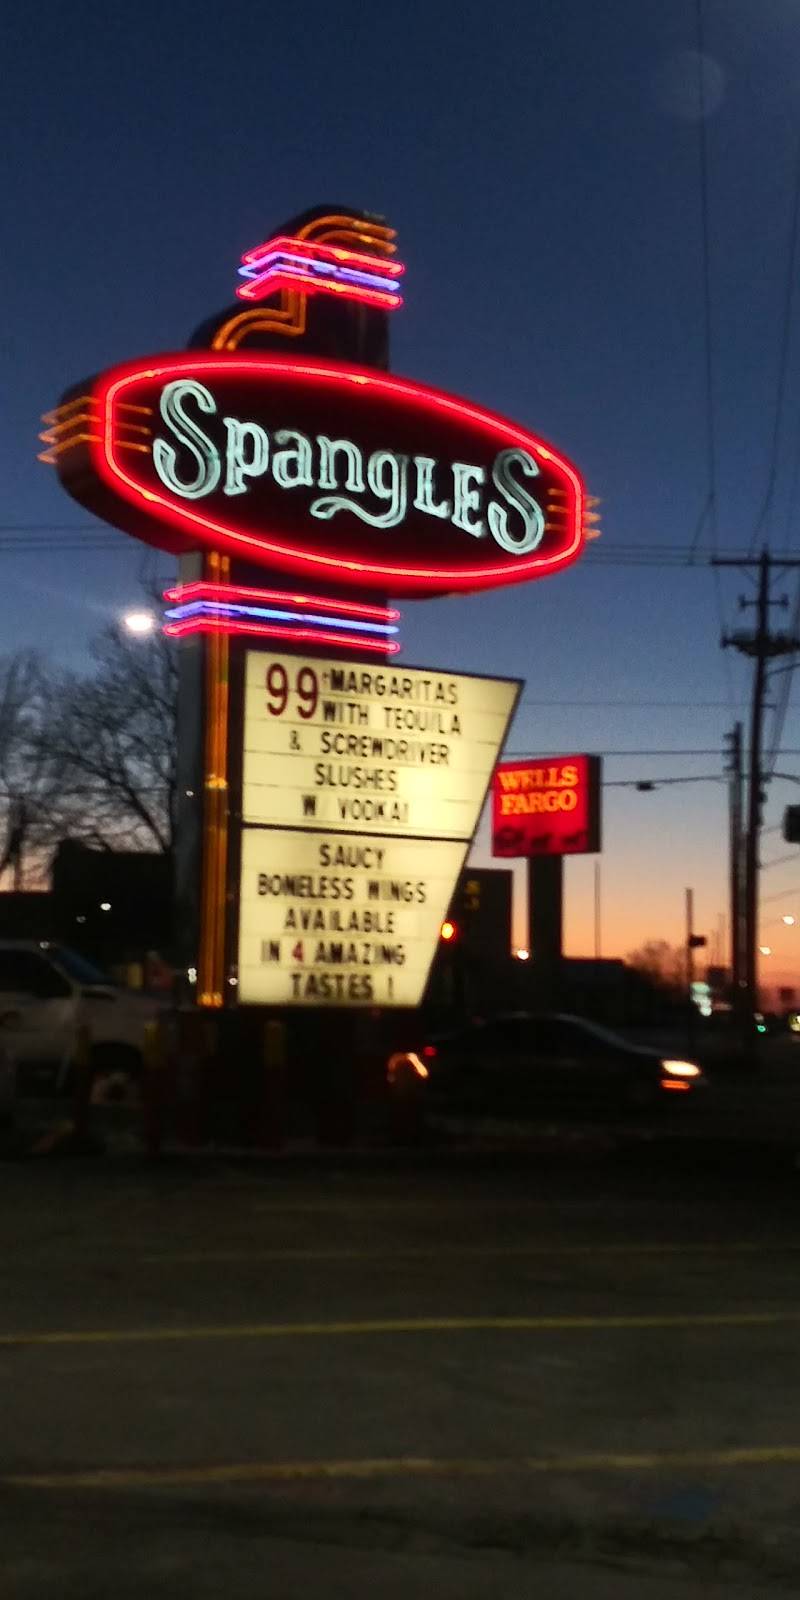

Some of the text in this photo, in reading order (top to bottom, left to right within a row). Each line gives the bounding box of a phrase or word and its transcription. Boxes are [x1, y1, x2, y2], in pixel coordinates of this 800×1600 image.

[329, 668, 458, 704] MARGARITAS
[322, 701, 369, 725] WITH
[289, 731, 449, 765] & SCREWDRIVER
[315, 763, 399, 791] SLUSHES
[498, 765, 578, 792] WELLS
[500, 789, 577, 816] FARGO
[319, 844, 386, 869] SAUCY
[258, 874, 427, 903] BONELESS WINGS
[284, 908, 395, 934] AVAILABLE
[261, 940, 406, 966] IN 4 AMAZING
[289, 973, 373, 1000] TASTES
